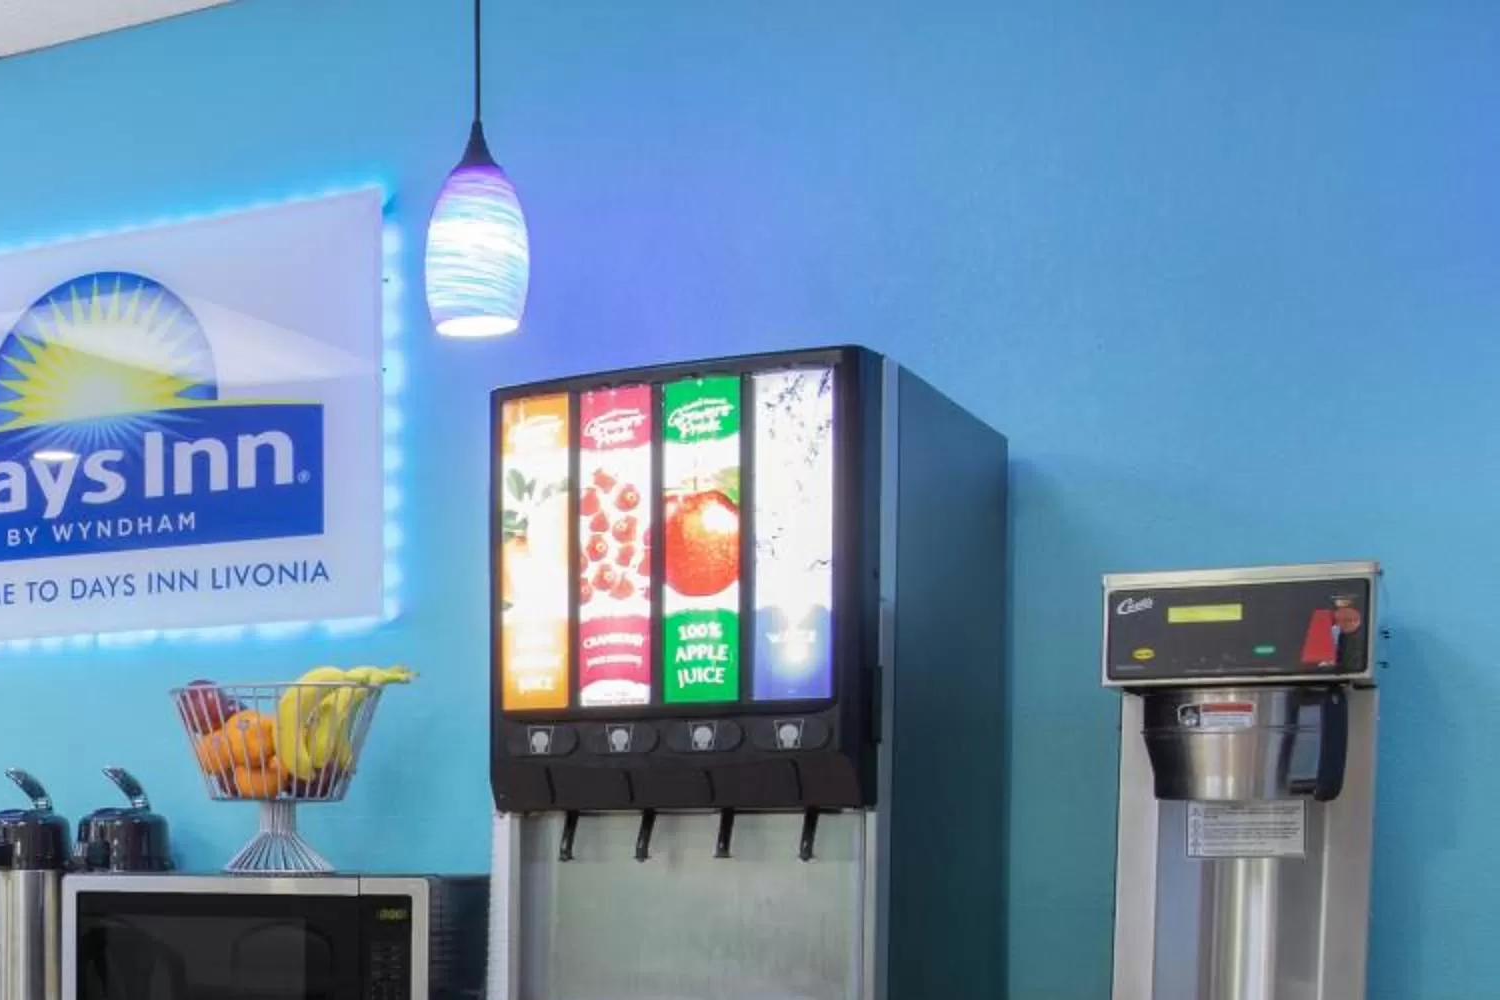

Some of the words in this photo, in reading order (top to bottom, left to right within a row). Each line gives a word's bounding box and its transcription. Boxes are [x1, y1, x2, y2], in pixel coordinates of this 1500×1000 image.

[143, 428, 294, 498] Inn
[7, 526, 38, 547] BY
[51, 511, 197, 543] WYNDHAM
[26, 578, 60, 603] TO
[70, 573, 137, 600] DAYS
[147, 569, 200, 594] INN
[211, 558, 331, 590] LIVONIA
[677, 620, 723, 640] 100%
[675, 644, 729, 664] APPLE
[677, 666, 725, 688] JUICE
